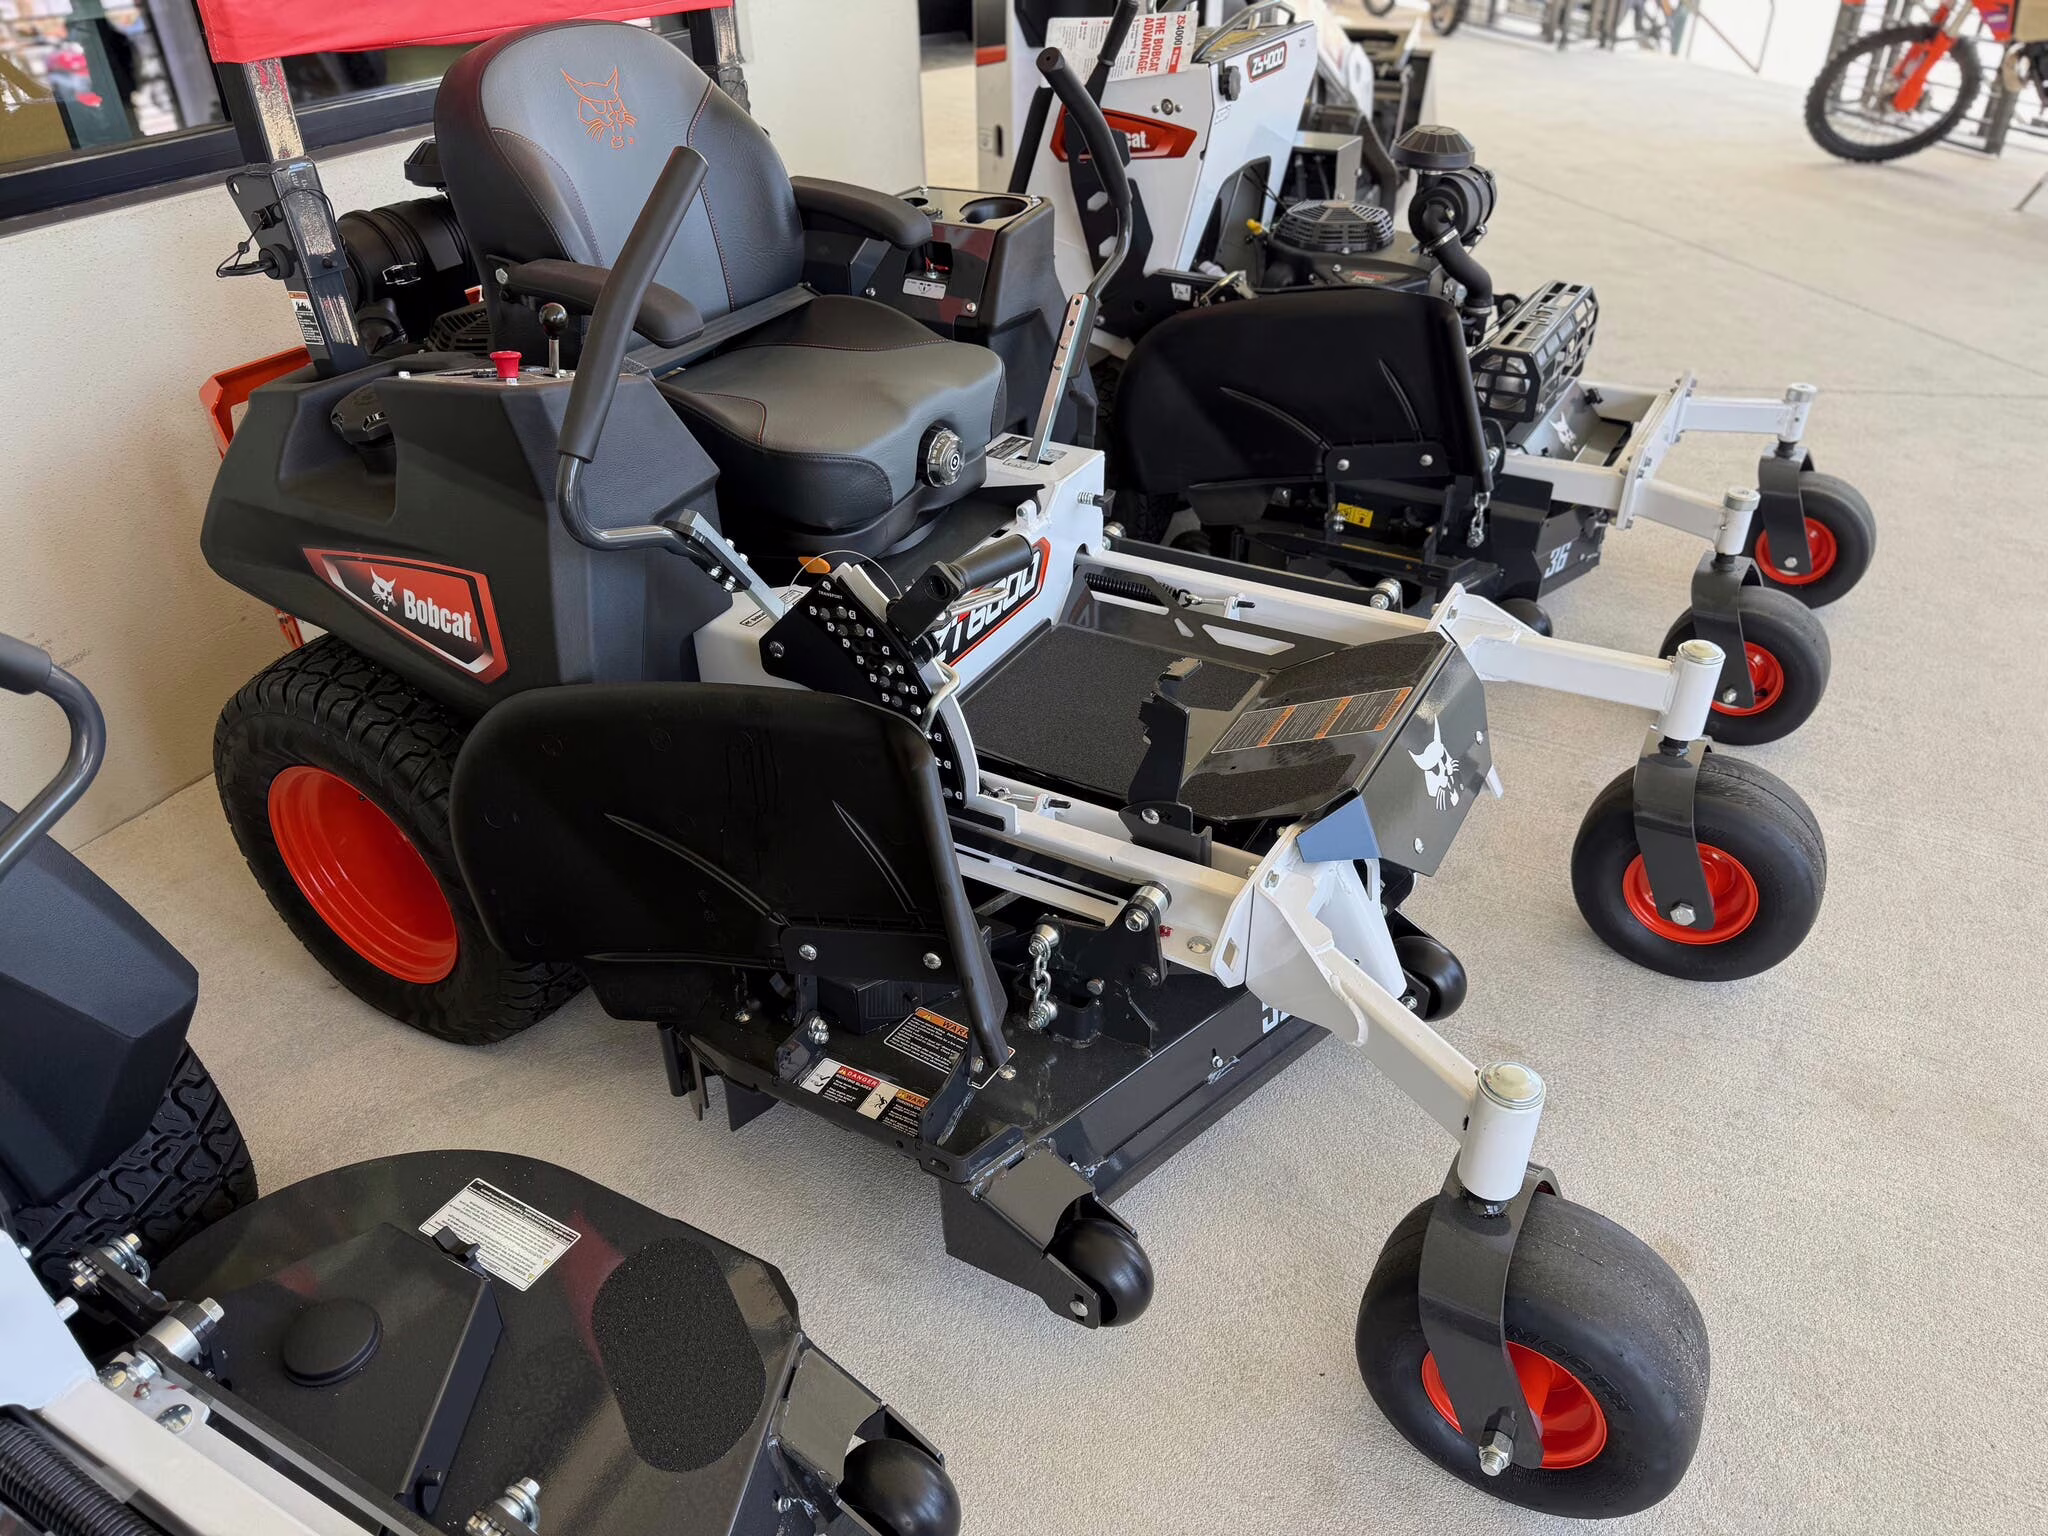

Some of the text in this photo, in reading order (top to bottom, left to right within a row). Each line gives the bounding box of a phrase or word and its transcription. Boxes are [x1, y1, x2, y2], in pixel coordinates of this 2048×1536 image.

[1135, 17, 1151, 75] ADVANTAGE:
[1148, 15, 1167, 73] THE BOBCAT
[1173, 14, 1187, 46] ZS4000
[1125, 130, 1148, 149] cat
[1543, 541, 1573, 579] 36
[818, 590, 843, 600] TRANSPORT
[402, 588, 475, 643] Bobcat
[846, 1070, 878, 1087] DANGER
